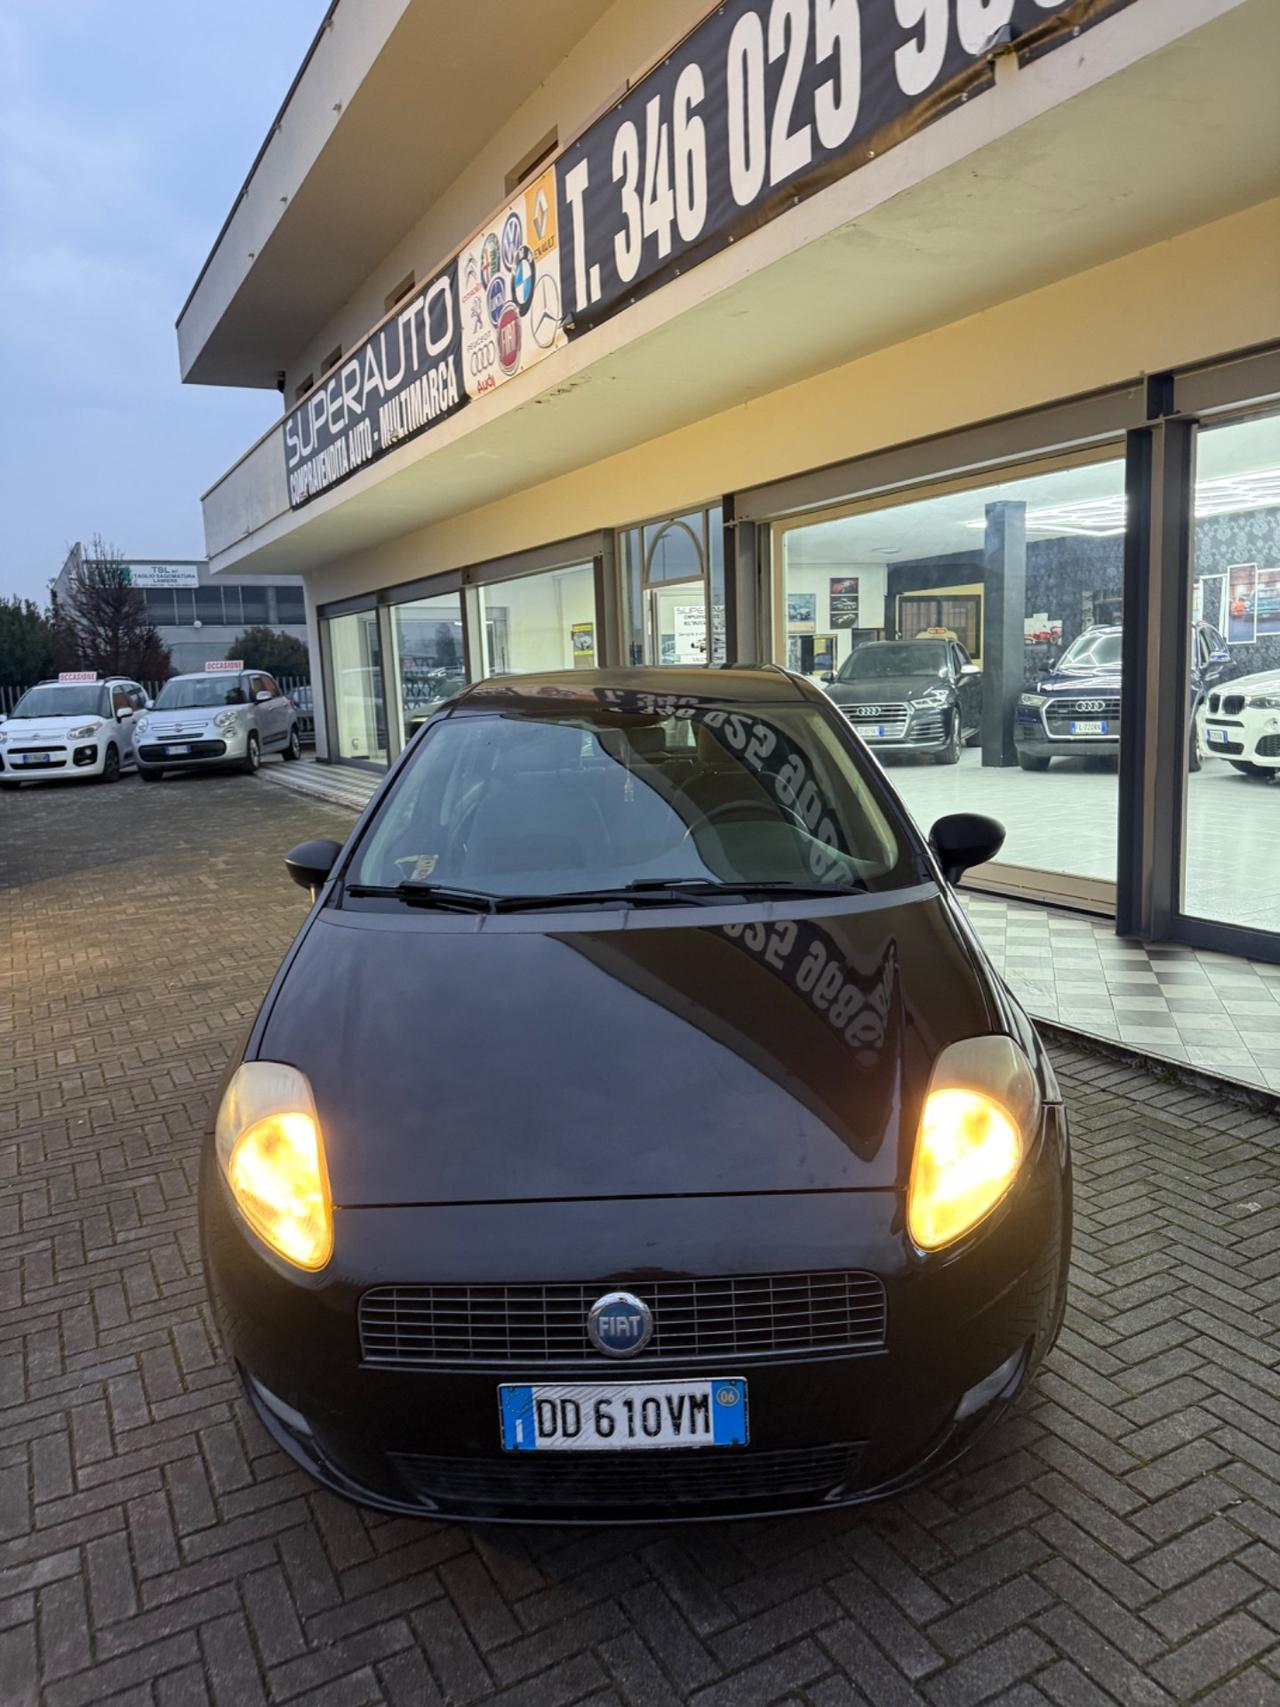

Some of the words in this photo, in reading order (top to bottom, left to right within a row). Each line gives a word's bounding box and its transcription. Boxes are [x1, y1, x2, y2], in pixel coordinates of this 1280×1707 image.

[565, 158, 601, 312] T.
[612, 62, 708, 283] 346
[727, 0, 861, 206] 025
[286, 275, 454, 468] SUPERAUTO
[476, 373, 496, 394] Audi
[349, 417, 373, 470] AUTO
[379, 354, 459, 449] MULTIMARCA
[60, 673, 96, 682] OCCASIONE
[206, 662, 243, 671] OCCASIONE
[599, 1315, 641, 1337] FIAT
[720, 1391, 735, 1404] 06
[535, 1399, 581, 1438] DD
[593, 1391, 711, 1438] 610VM
